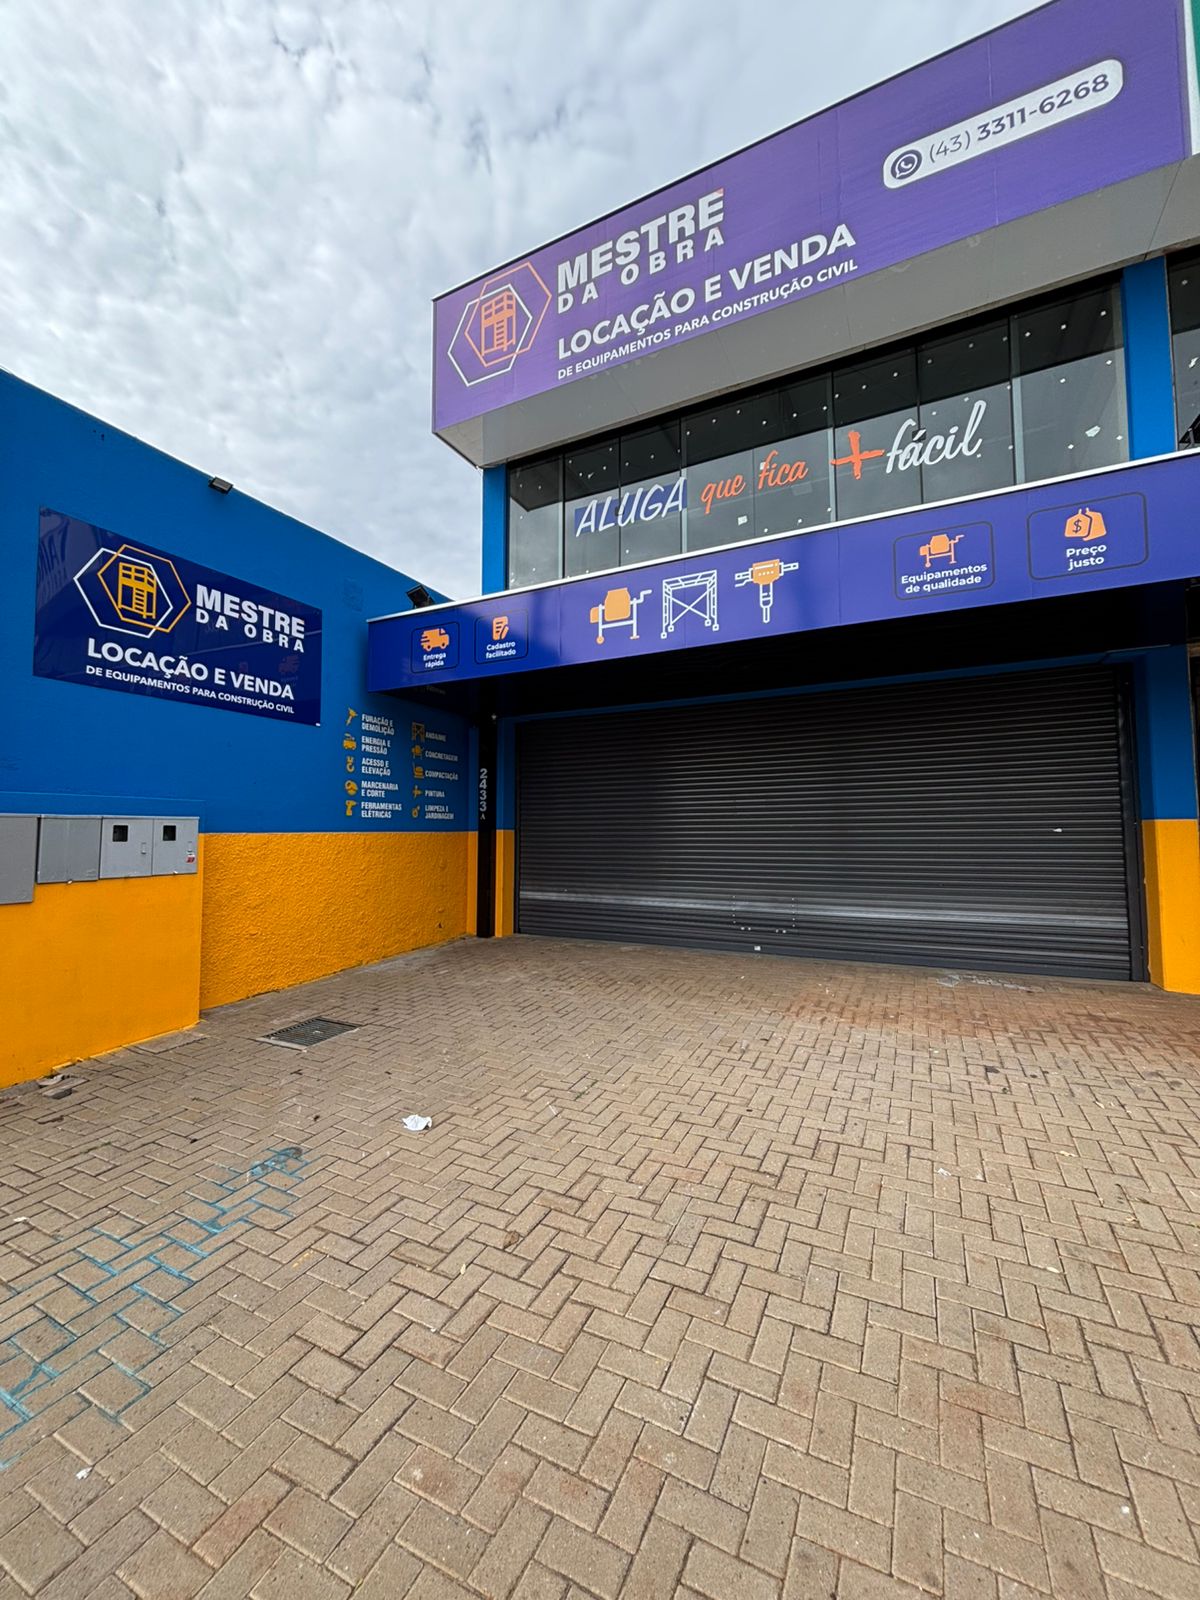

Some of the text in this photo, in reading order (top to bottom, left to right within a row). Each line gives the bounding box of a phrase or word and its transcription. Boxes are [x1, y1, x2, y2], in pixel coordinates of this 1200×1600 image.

[928, 73, 1110, 163] (43) 3311-6268
[557, 188, 725, 293] MESTRE
[557, 227, 725, 314] DA OBRA
[558, 223, 857, 360] LOCAÇÃO E VENDA
[557, 259, 859, 380] DE EQUIPAMENTOS PARA CONSTRUÇÃO CIVIL
[575, 476, 687, 538] ALUGA
[700, 475, 746, 515] que
[757, 449, 809, 490] fica
[831, 431, 885, 480] +
[1066, 543, 1107, 560] Preço
[1068, 556, 1105, 571] justo
[901, 563, 988, 584] Equipamentos
[905, 574, 982, 594] de qualidade
[196, 584, 305, 639] MESTRE
[196, 608, 304, 653] DA OBRA
[486, 641, 516, 651] Cadastro
[423, 652, 447, 662] Entrega
[485, 649, 516, 659] facilitado
[87, 638, 295, 701] LOCAÇÃO E VENDA
[425, 659, 444, 668] rápida
[86, 665, 295, 714] DE EQUIPAMENTOS PARA CONSTRUÇÃO CIVIL
[362, 713, 389, 726] FURAÇÃO
[362, 722, 394, 735] DEMOLIÇÃO
[362, 735, 387, 746] ENERGIA
[362, 744, 388, 755] PRESSÃO
[362, 757, 385, 767] ACESSO
[362, 767, 391, 777] ELEVAÇÃO
[362, 780, 399, 791] MARCENARIA
[479, 768, 488, 812] 2433
[366, 790, 386, 798] CORTE
[362, 801, 402, 811] FERRAMENTAS
[362, 809, 392, 819] ELÉTRICAS
